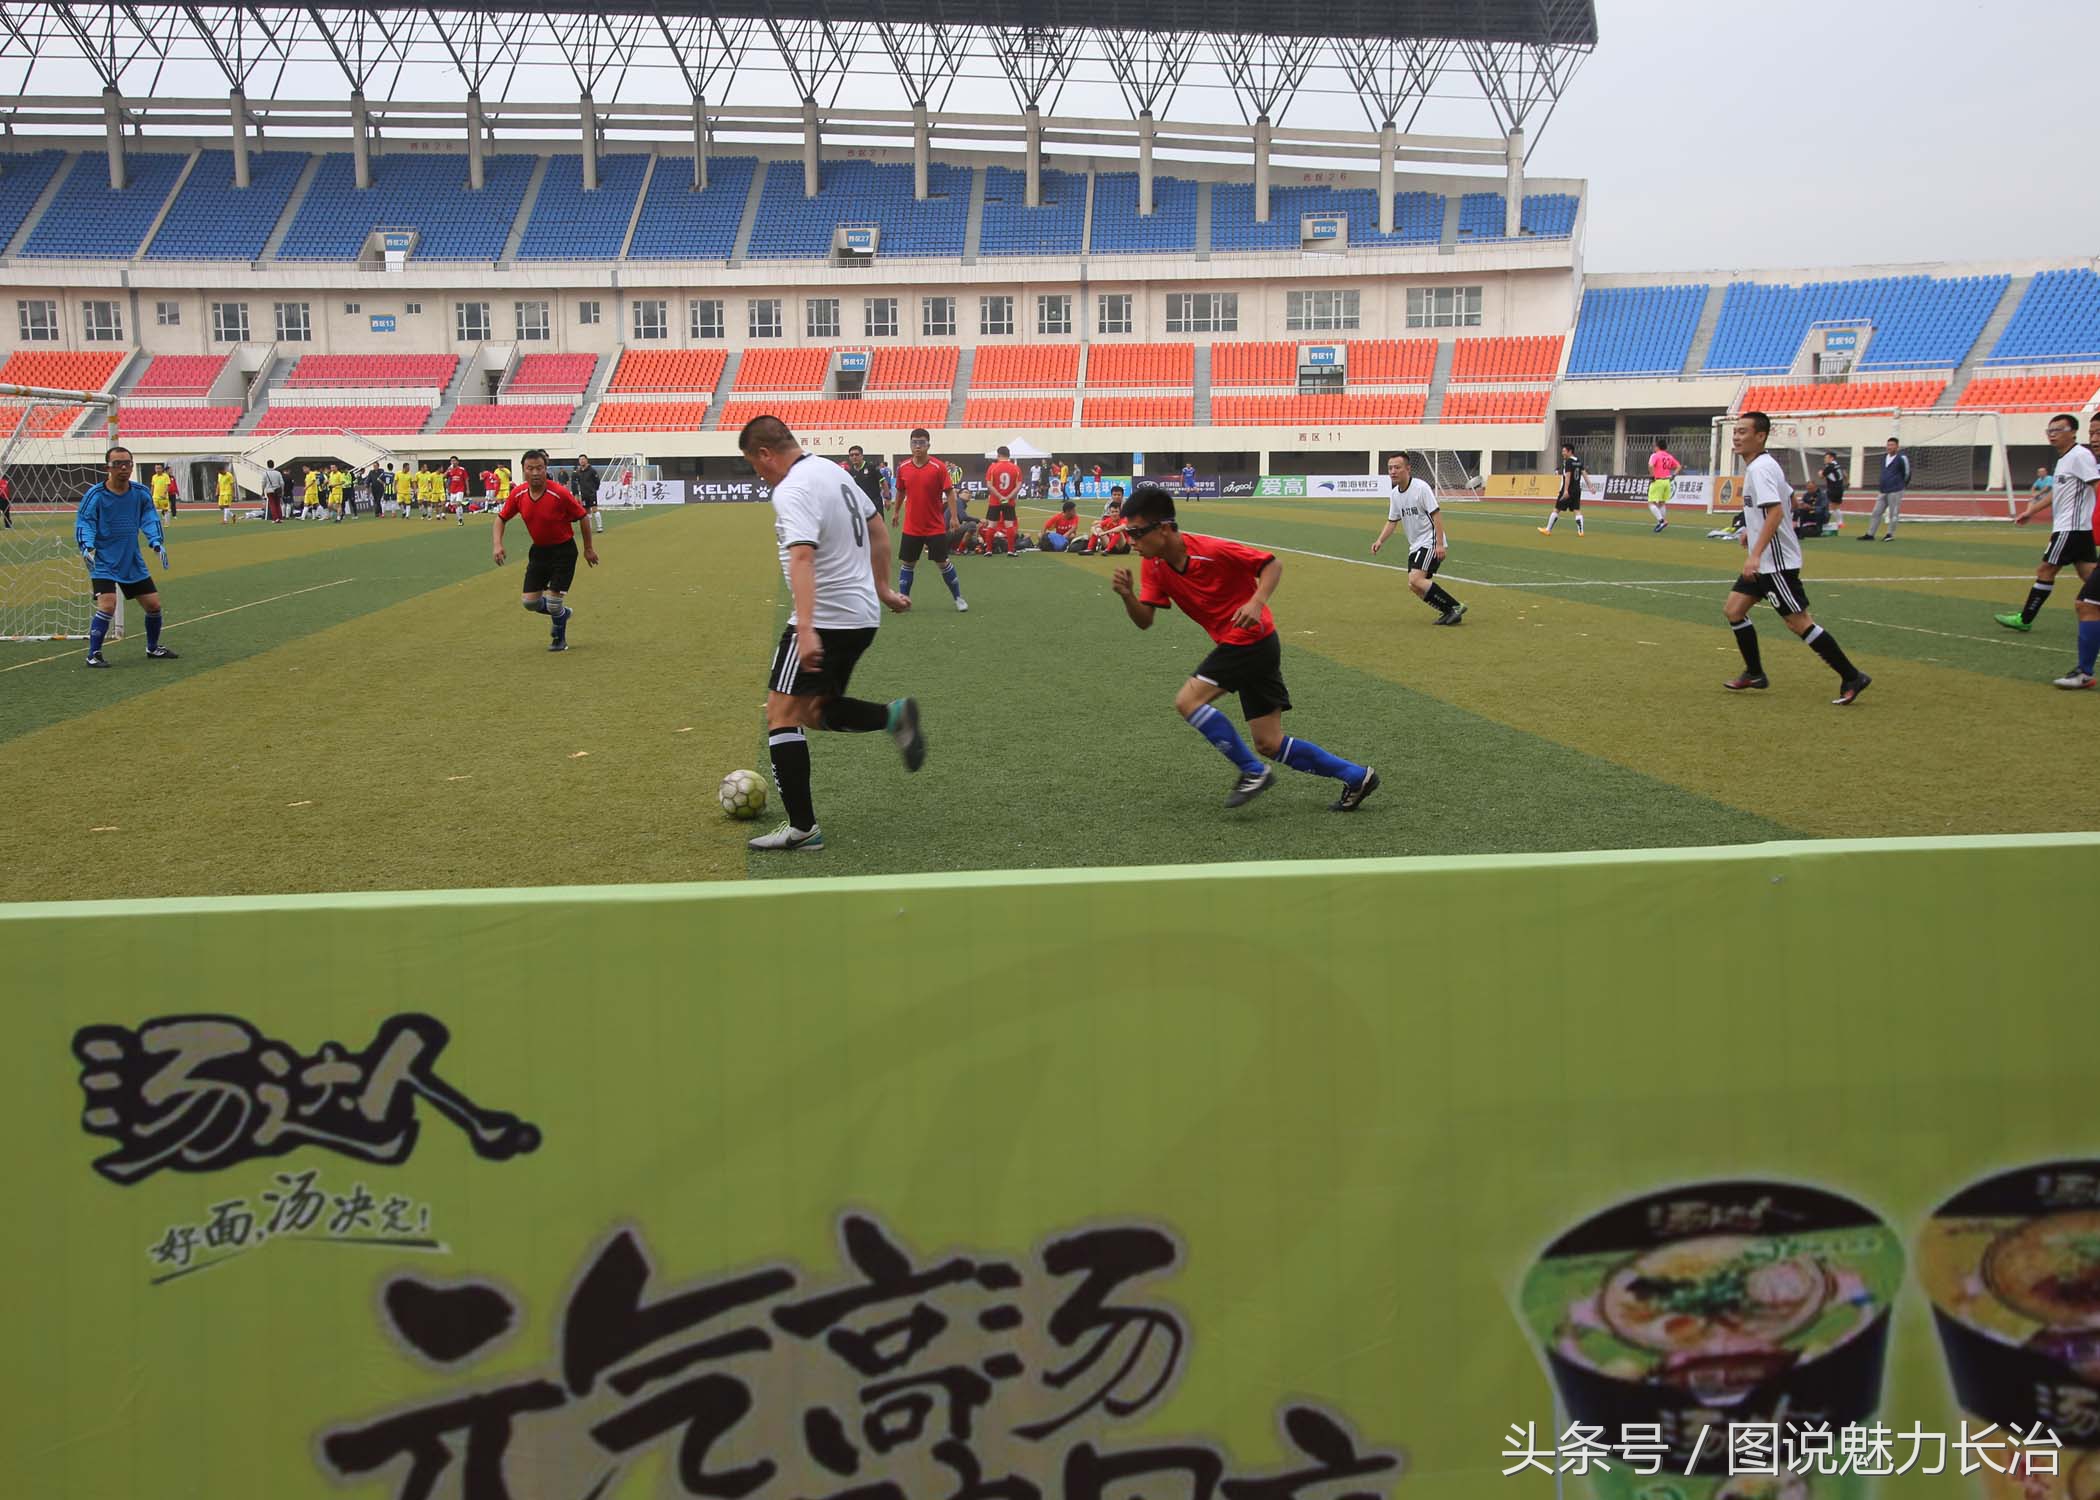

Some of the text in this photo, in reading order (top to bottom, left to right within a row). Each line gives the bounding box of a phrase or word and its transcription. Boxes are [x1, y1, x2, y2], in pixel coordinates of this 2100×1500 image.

[692, 483, 753, 495] KELME
[999, 472, 1010, 490] 9
[1261, 478, 1304, 496] 爱高
[841, 483, 864, 548] 8
[72, 1013, 542, 1186] 汤达人
